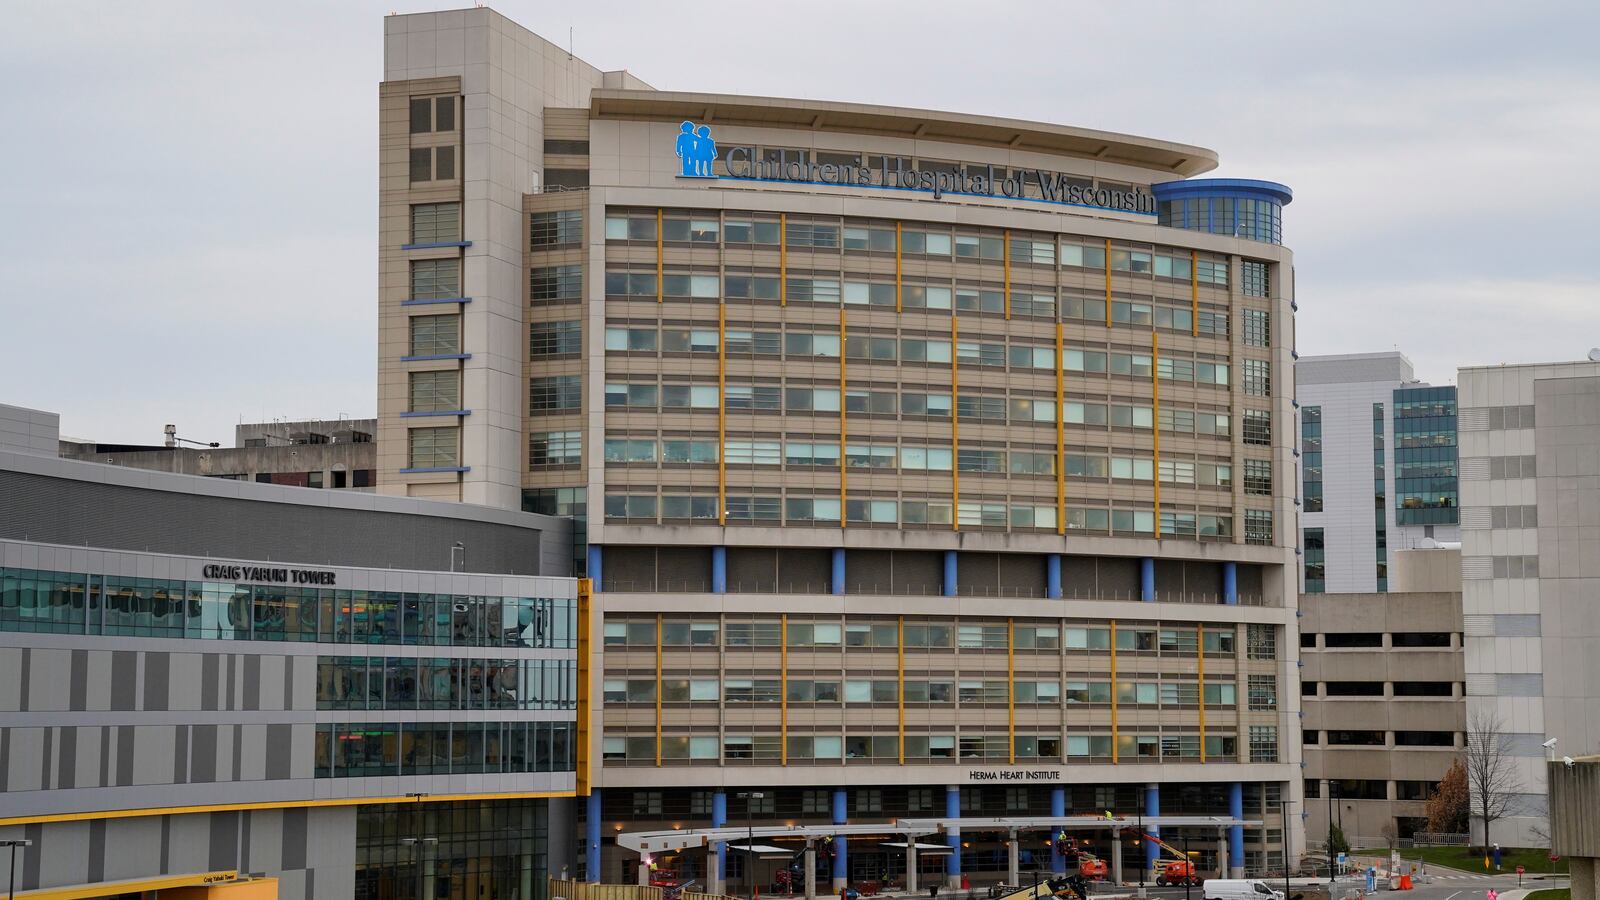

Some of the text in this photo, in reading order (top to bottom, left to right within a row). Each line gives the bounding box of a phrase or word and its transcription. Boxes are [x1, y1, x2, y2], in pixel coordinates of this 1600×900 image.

[726, 146, 1157, 214] Children's Hospital of Wisconsin
[203, 564, 336, 585] CRAIG YABUKI TOWER
[969, 771, 1060, 780] HERMA HEART INSTITUTE
